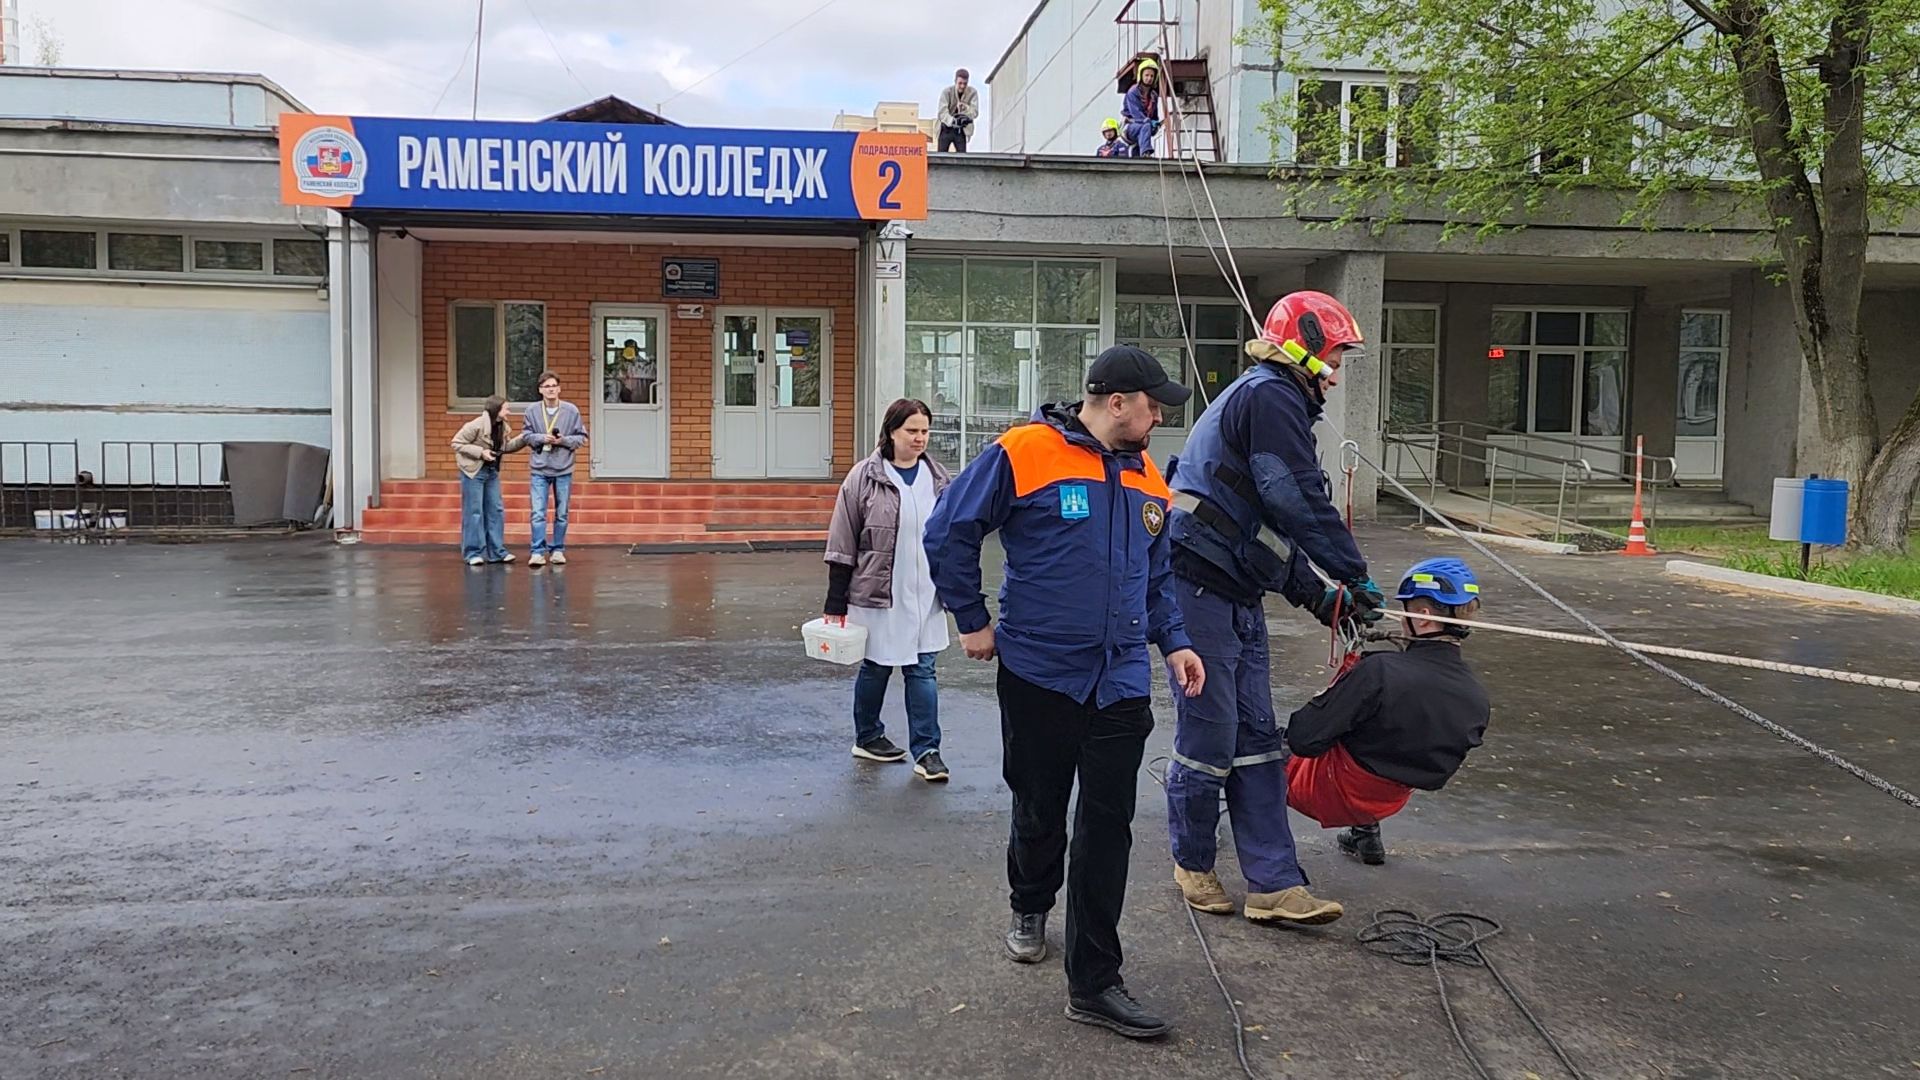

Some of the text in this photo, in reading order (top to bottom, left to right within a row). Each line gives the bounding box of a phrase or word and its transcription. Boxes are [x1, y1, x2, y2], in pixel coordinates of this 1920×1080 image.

[398, 131, 829, 205] РАМЕНСКИЙ КОЛЛЕДЖ
[858, 144, 924, 157] ПОДРАЗДЕЛЕНИЕ
[878, 159, 902, 210] 2
